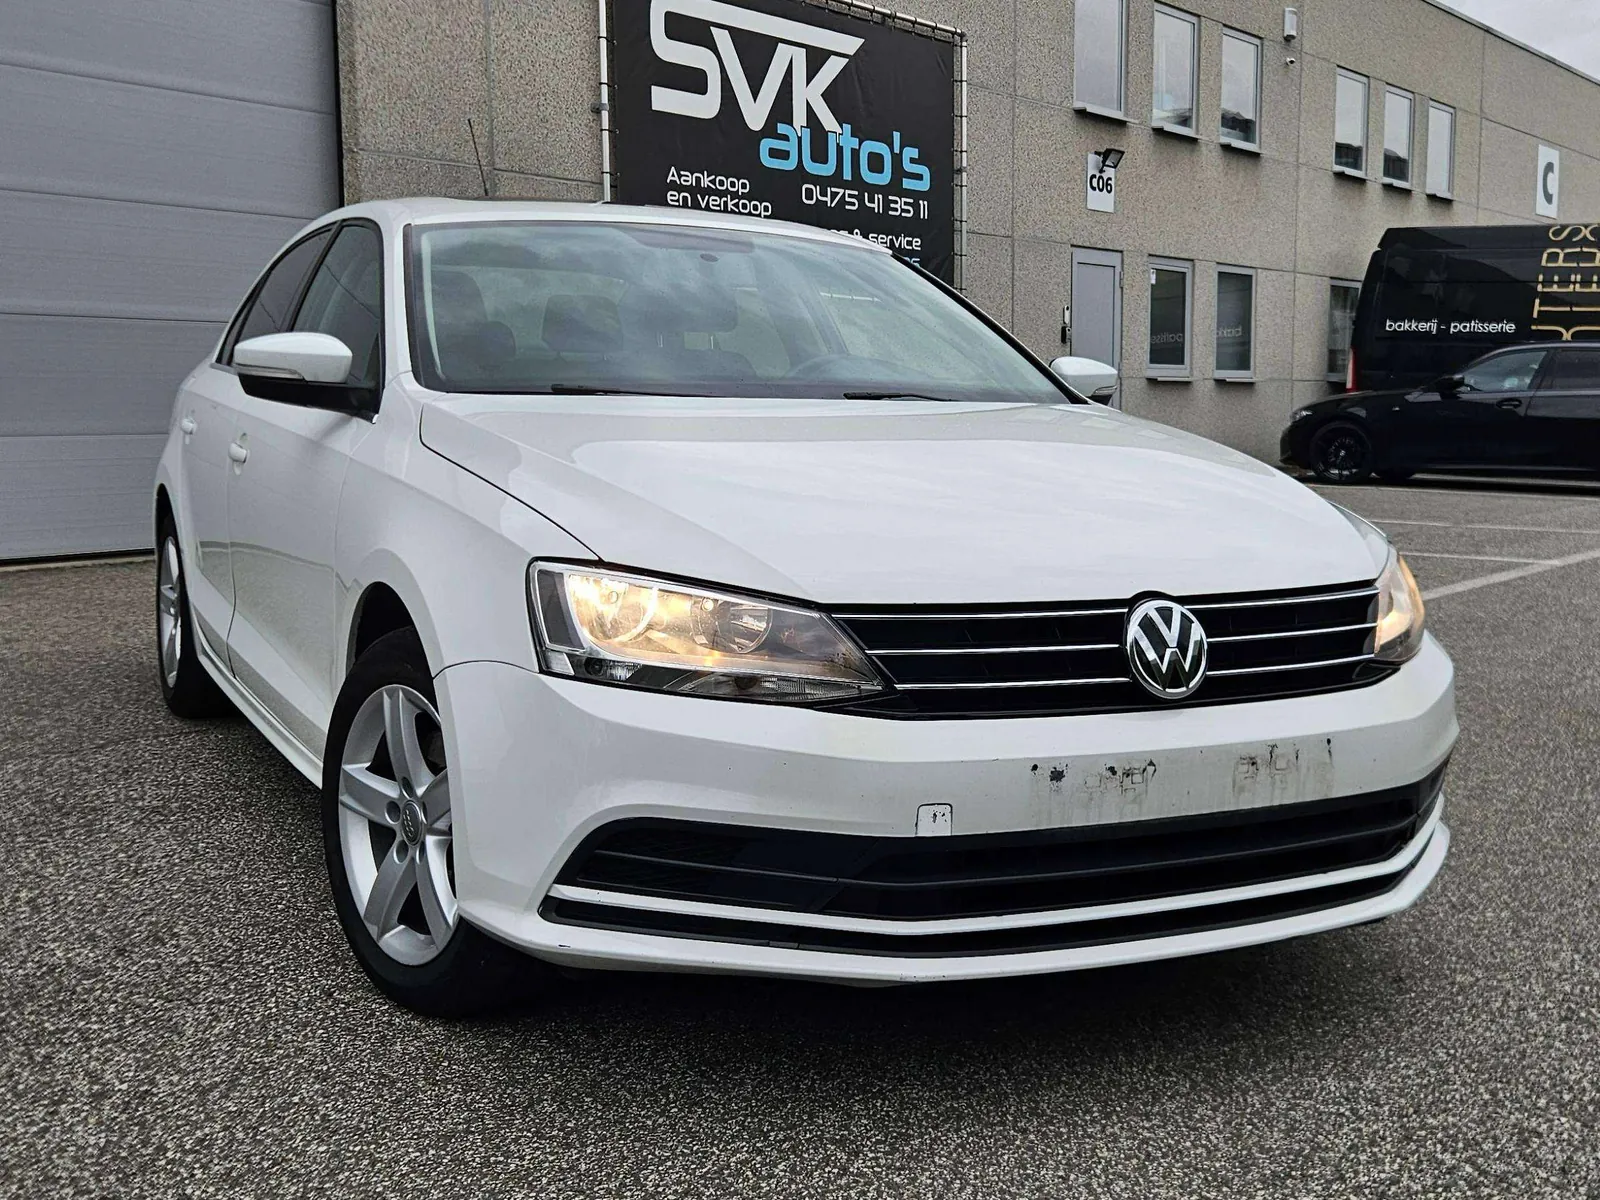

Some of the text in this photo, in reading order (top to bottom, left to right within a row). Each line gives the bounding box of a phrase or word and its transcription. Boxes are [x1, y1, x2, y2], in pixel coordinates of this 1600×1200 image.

[650, 0, 865, 136] SVK
[759, 122, 931, 192] auto's
[666, 166, 750, 194] Aankoop
[1542, 161, 1555, 206] C
[667, 192, 772, 218] en verkoop
[801, 183, 929, 220] 0475 41 35 11
[868, 233, 922, 251] service
[1385, 318, 1438, 335] bakkerij
[1449, 320, 1517, 335] patisserie
